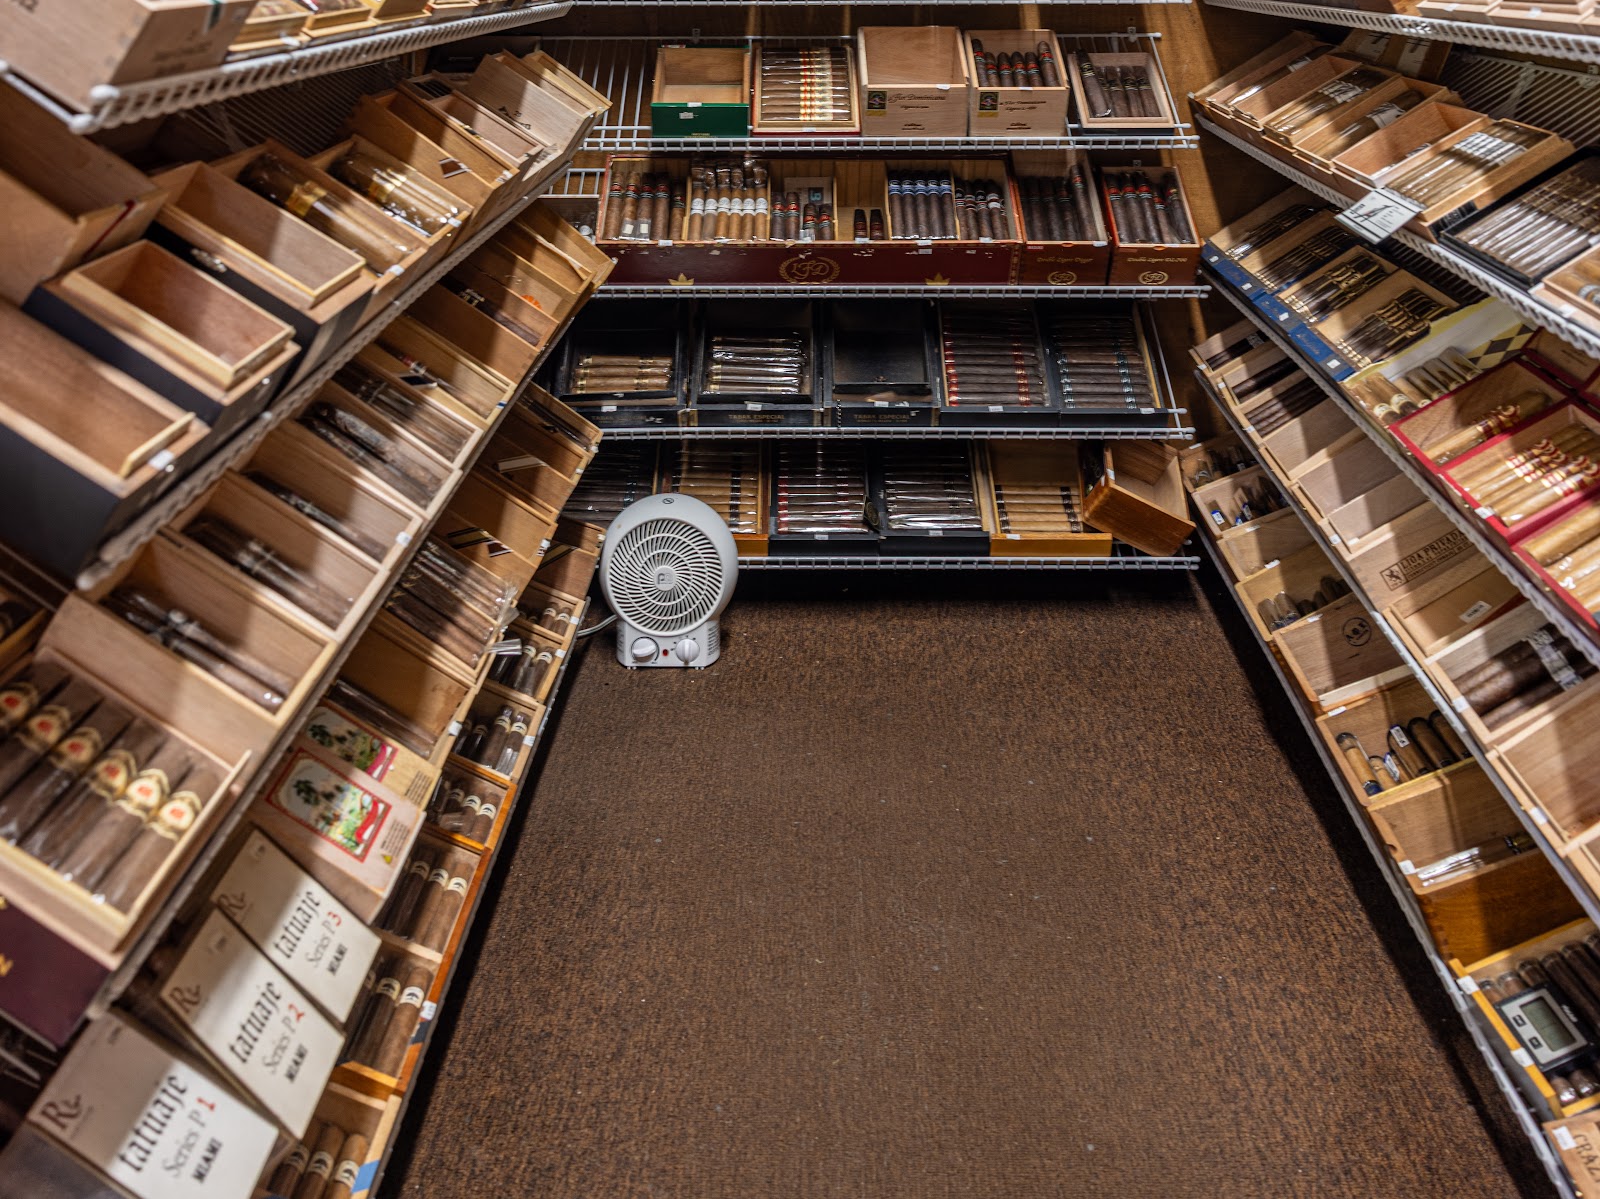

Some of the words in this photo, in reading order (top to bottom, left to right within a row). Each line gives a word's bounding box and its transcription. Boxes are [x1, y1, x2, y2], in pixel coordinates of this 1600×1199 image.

[1401, 554, 1424, 570] LIGA
[272, 891, 321, 960] tatuaje
[322, 918, 337, 933] P
[327, 910, 342, 927] 3
[304, 931, 331, 969] Series
[326, 942, 349, 976] MIAMI
[227, 981, 282, 1065] tatuaje
[282, 1015, 299, 1032] P
[288, 1003, 305, 1022] 2
[262, 1031, 290, 1075] Series
[284, 1045, 309, 1084] MIAMI
[118, 1075, 188, 1172] tatuaje
[189, 1110, 208, 1128] P
[196, 1097, 216, 1112] 1
[162, 1127, 199, 1178] Series
[192, 1137, 223, 1184] MIAMI
[1574, 1133, 1600, 1185] CRAZ
